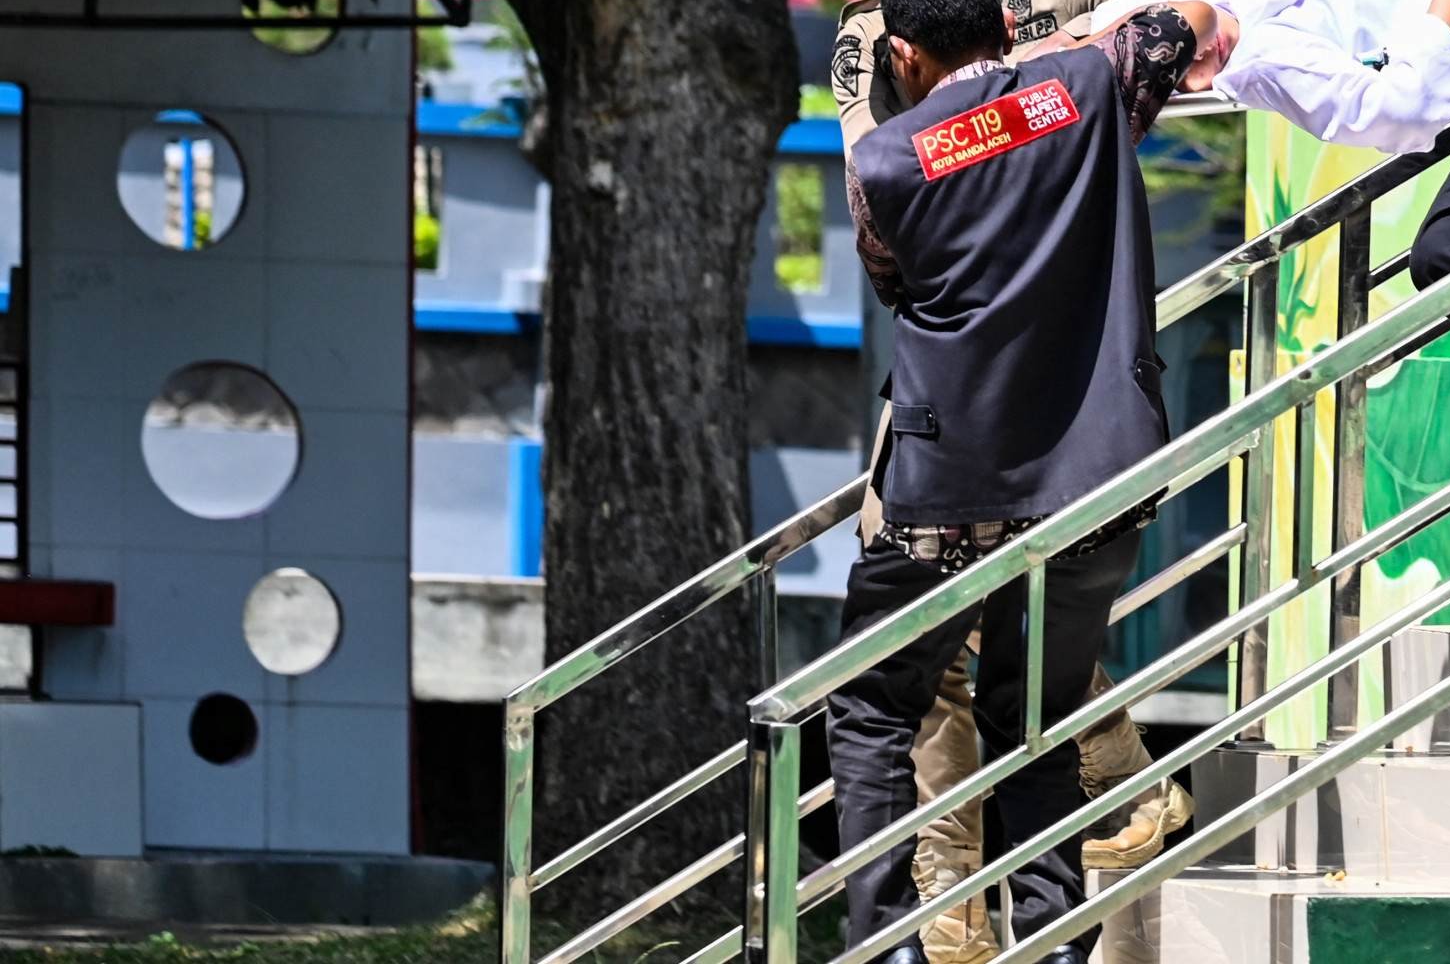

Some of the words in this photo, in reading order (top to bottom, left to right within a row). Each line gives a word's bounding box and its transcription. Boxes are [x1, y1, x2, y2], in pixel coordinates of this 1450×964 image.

[1017, 85, 1058, 108] PUBLIC
[1024, 96, 1063, 120] SAFETY
[1028, 107, 1071, 131] CENTER
[922, 122, 969, 159] PSC
[970, 108, 1002, 139] 119
[931, 156, 956, 172] KOTA
[955, 143, 986, 163] BANDA
[986, 132, 1012, 150] ACEH
